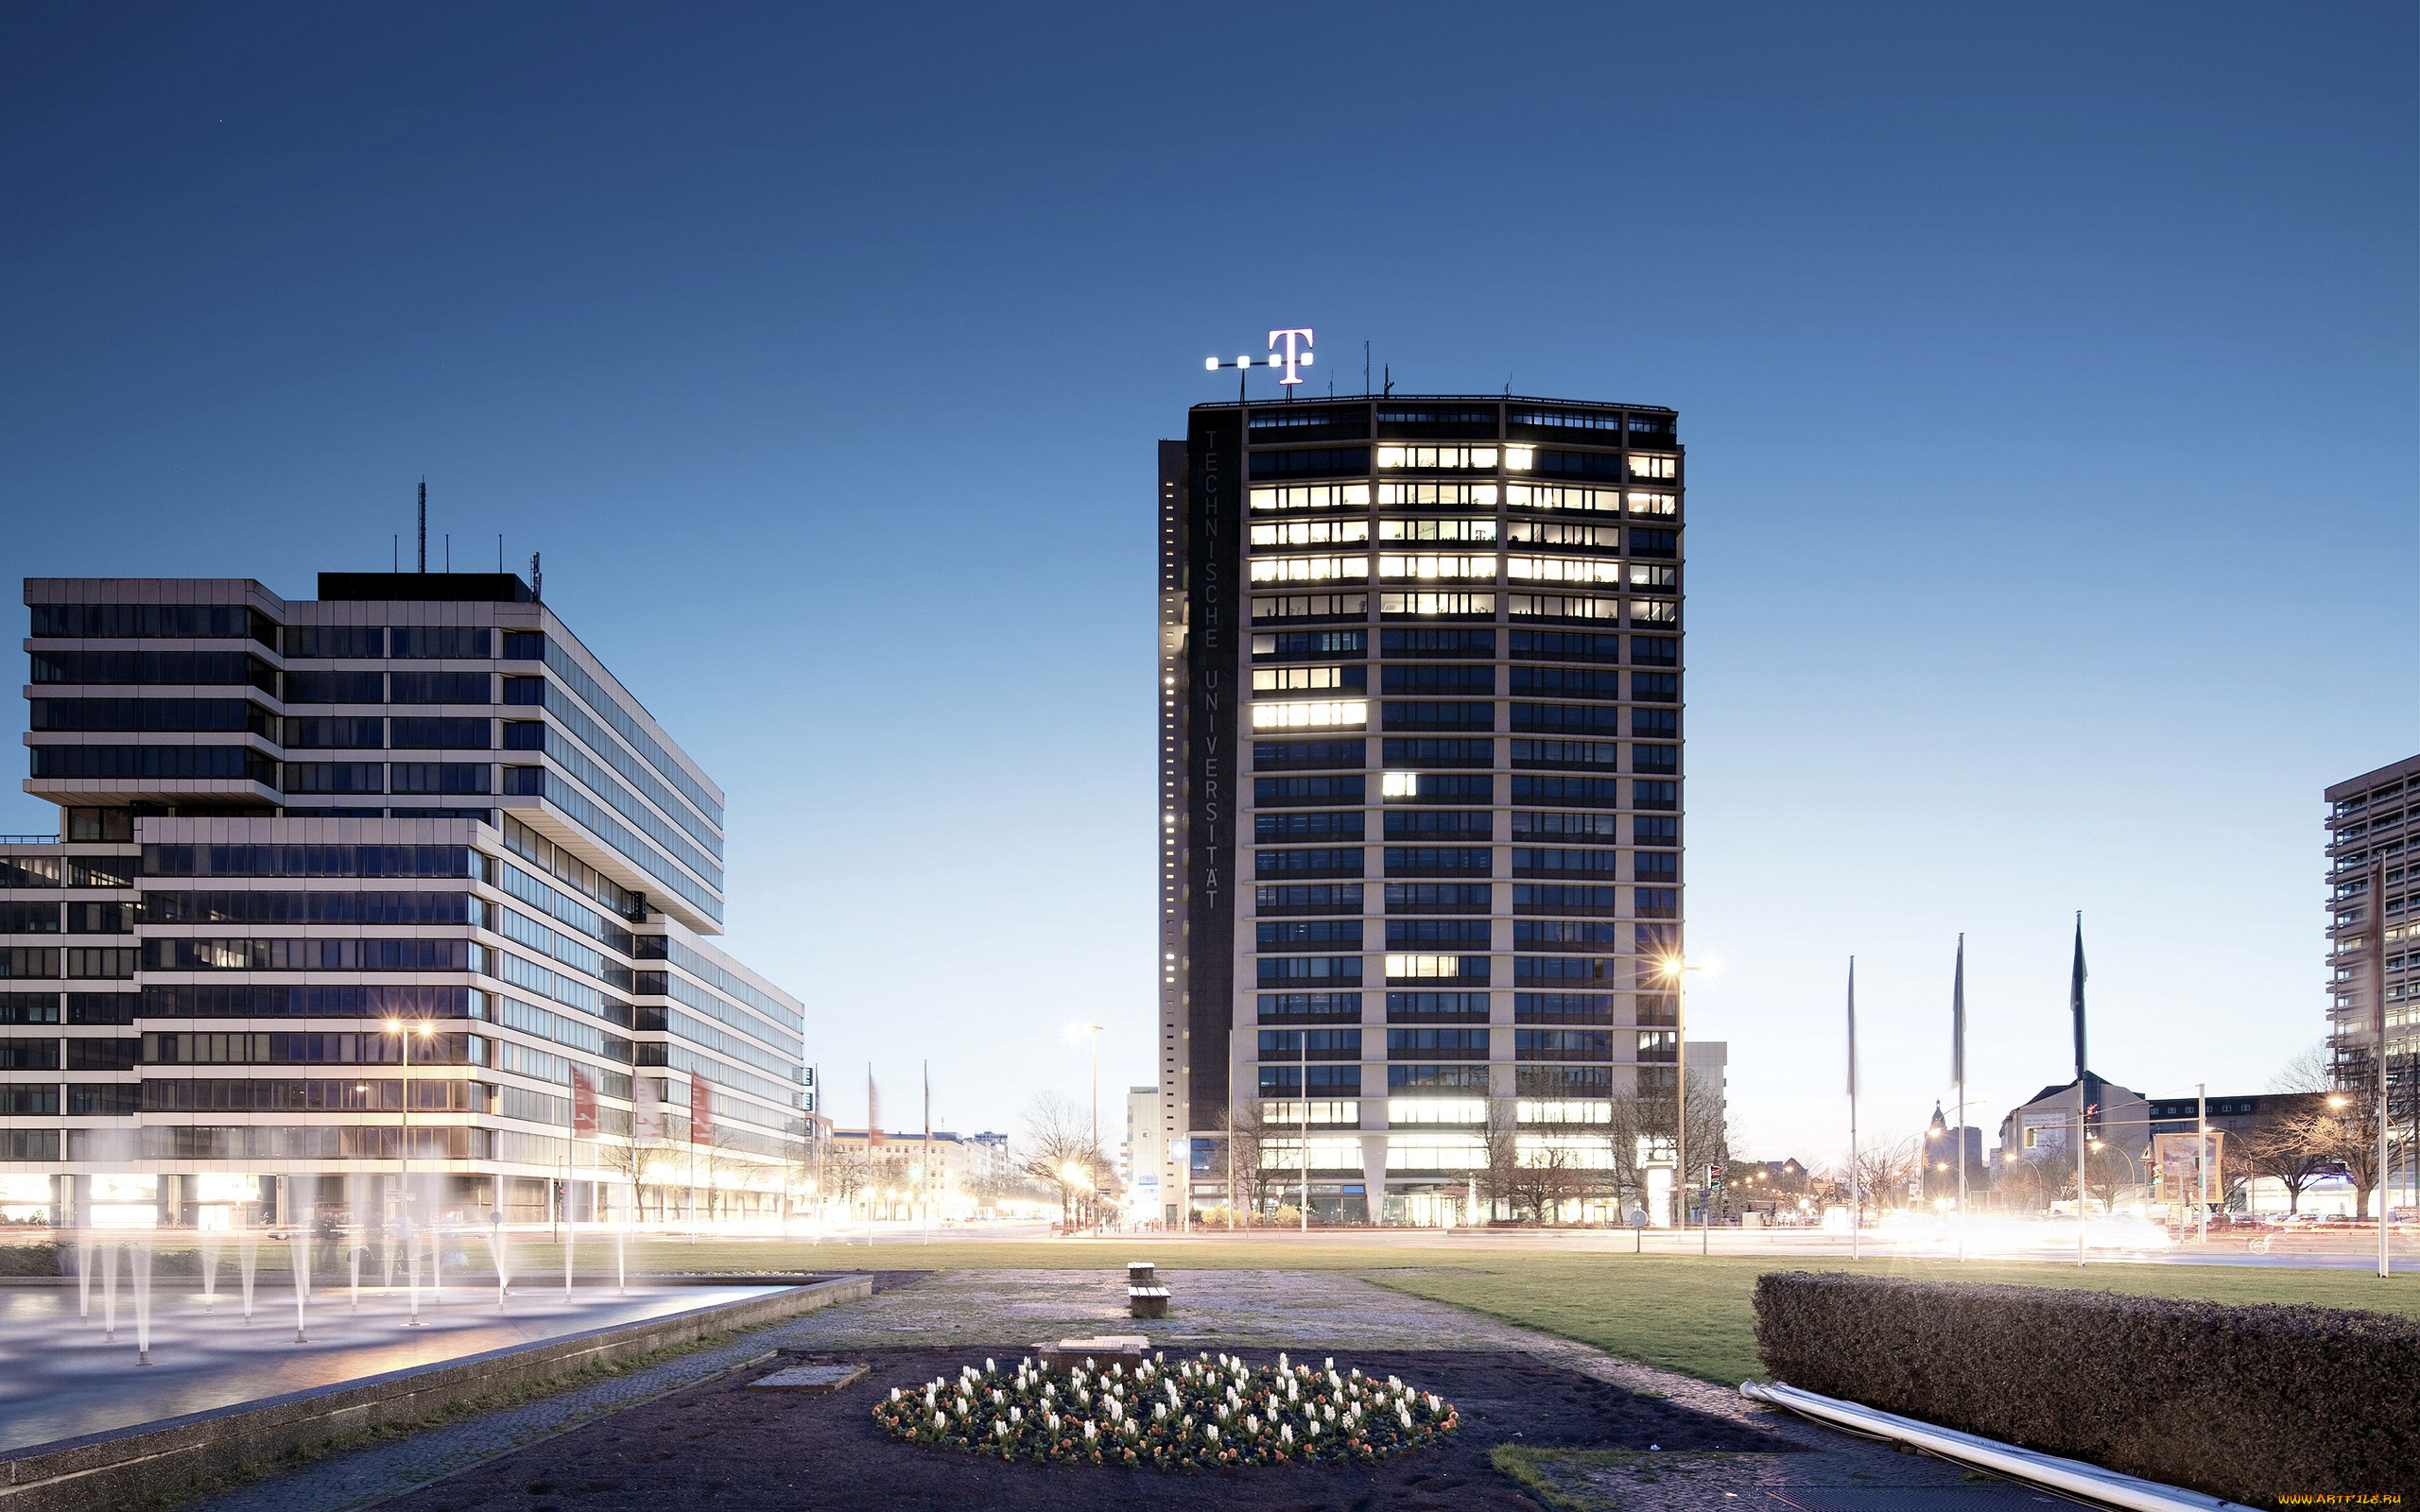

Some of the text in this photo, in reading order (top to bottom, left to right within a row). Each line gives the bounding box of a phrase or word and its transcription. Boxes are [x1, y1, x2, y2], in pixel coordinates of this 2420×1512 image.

[1268, 328, 1314, 385] T
[1205, 430, 1218, 909] TECHNISCHE UNIVERSITÄT
